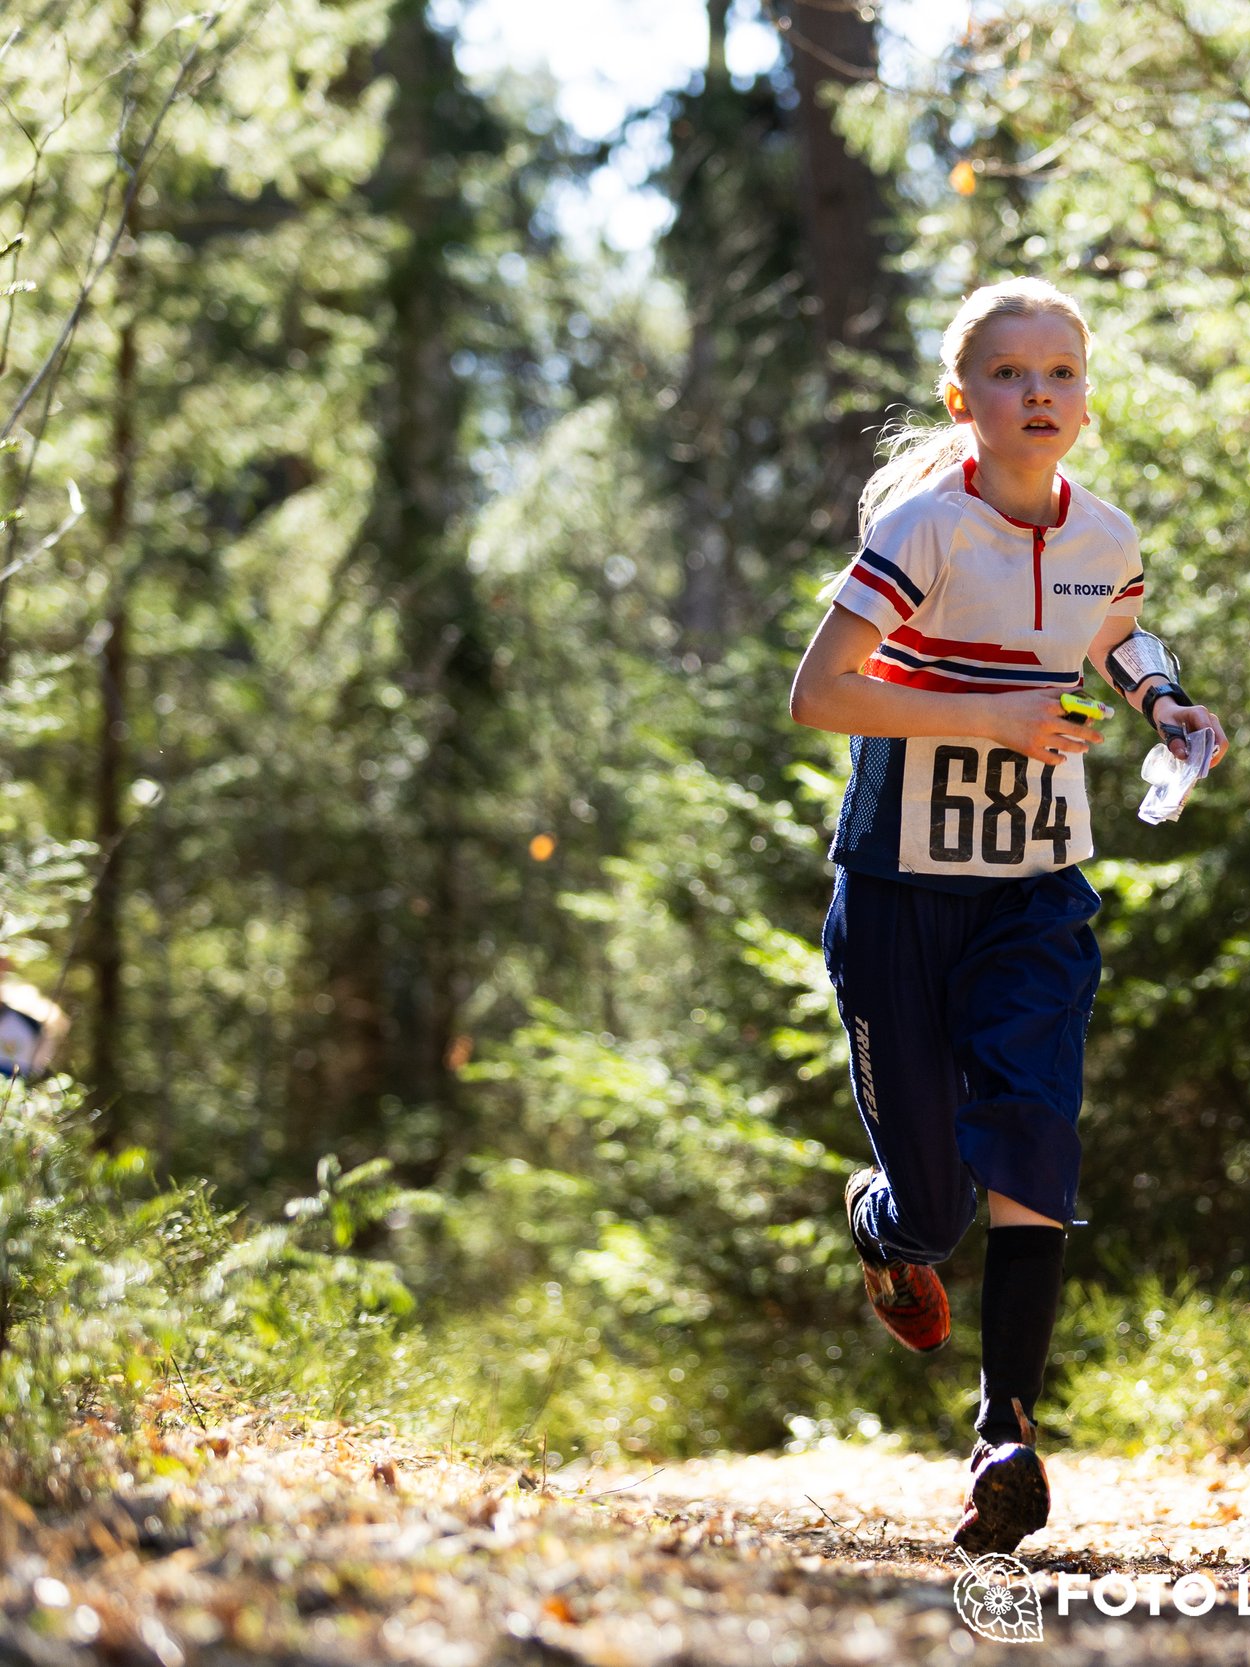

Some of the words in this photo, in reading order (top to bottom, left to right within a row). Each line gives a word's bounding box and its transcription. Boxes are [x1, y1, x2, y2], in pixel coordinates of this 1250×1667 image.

[1053, 583, 1072, 595] OK
[1074, 584, 1115, 596] ROXEN
[929, 744, 1071, 865] 684
[854, 1015, 880, 1125] TRIMTEX
